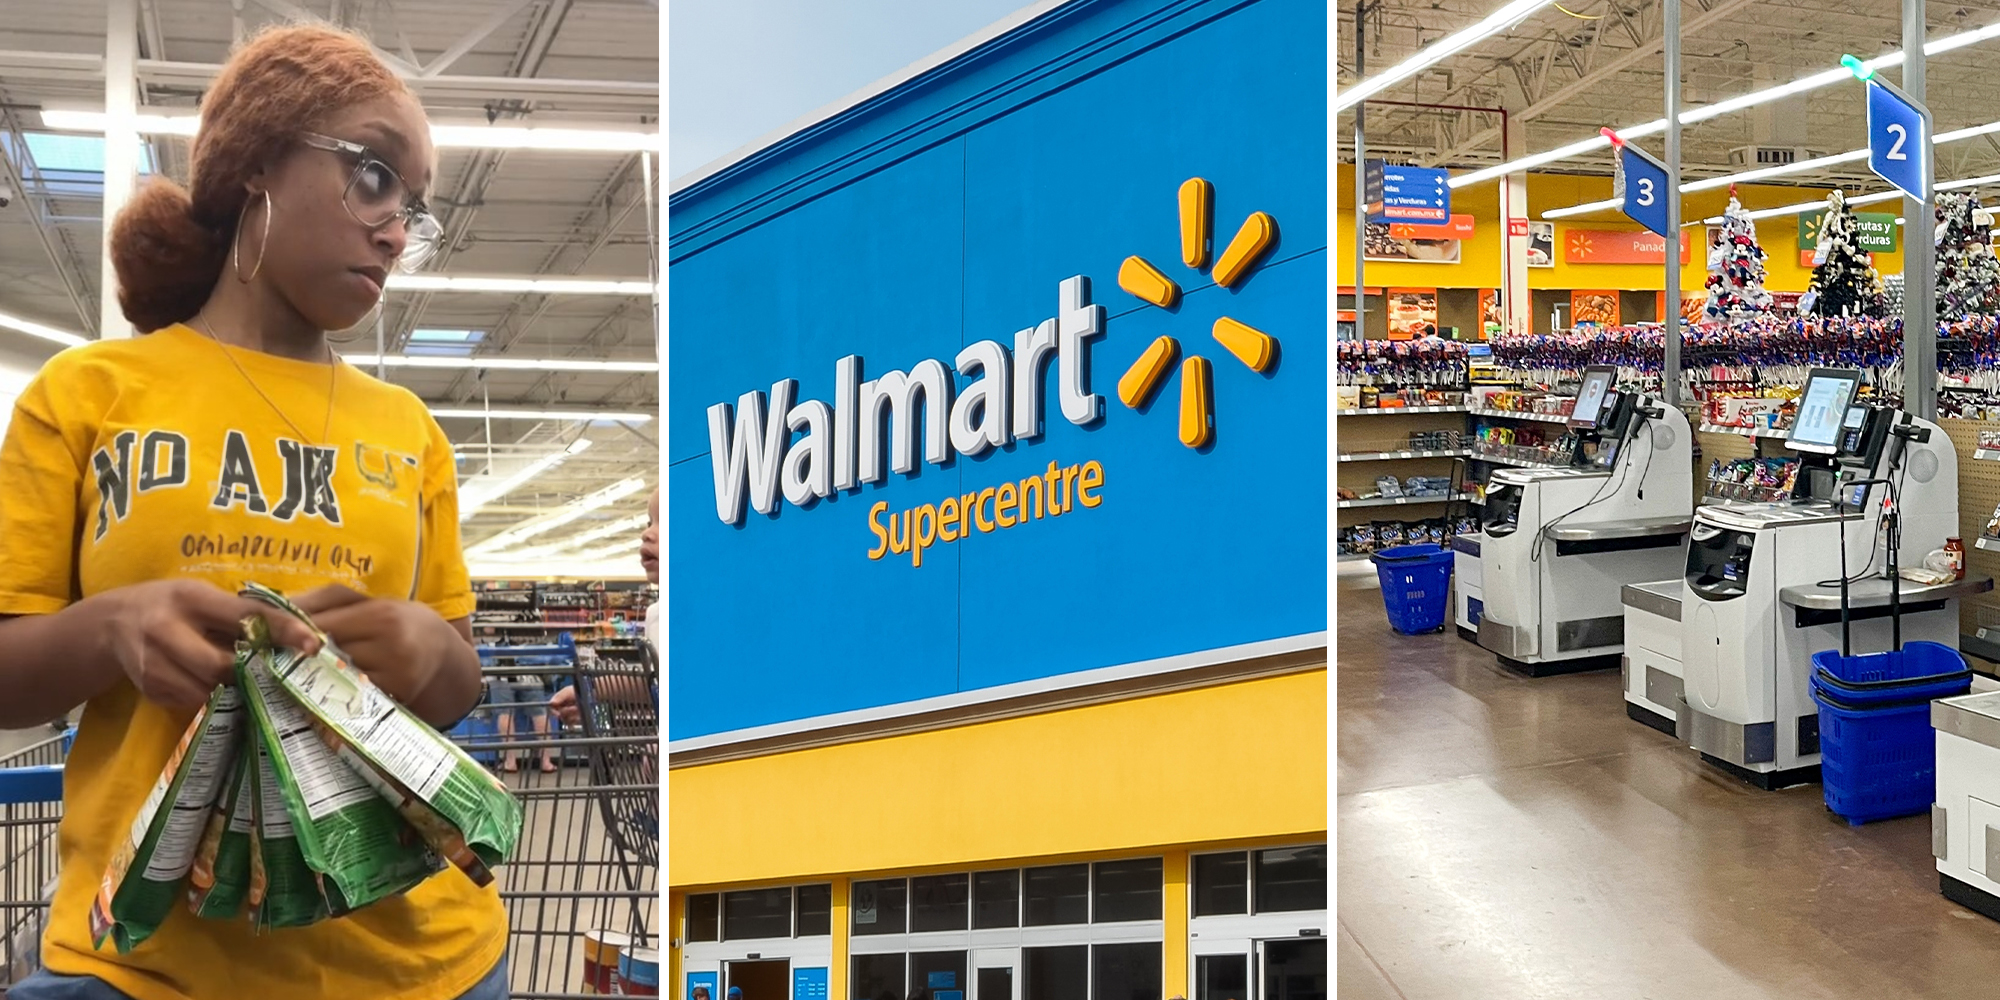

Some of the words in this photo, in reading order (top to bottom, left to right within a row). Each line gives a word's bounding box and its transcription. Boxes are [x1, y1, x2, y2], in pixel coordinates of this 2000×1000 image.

[1886, 123, 1907, 160] 2
[1636, 177, 1655, 207] 3
[1856, 233, 1891, 245] rduras
[1857, 221, 1883, 232] rutas
[1884, 223, 1891, 234] y
[1633, 241, 1685, 252] Panada
[706, 273, 1104, 526] Walmart
[867, 459, 1105, 568] Supercentre
